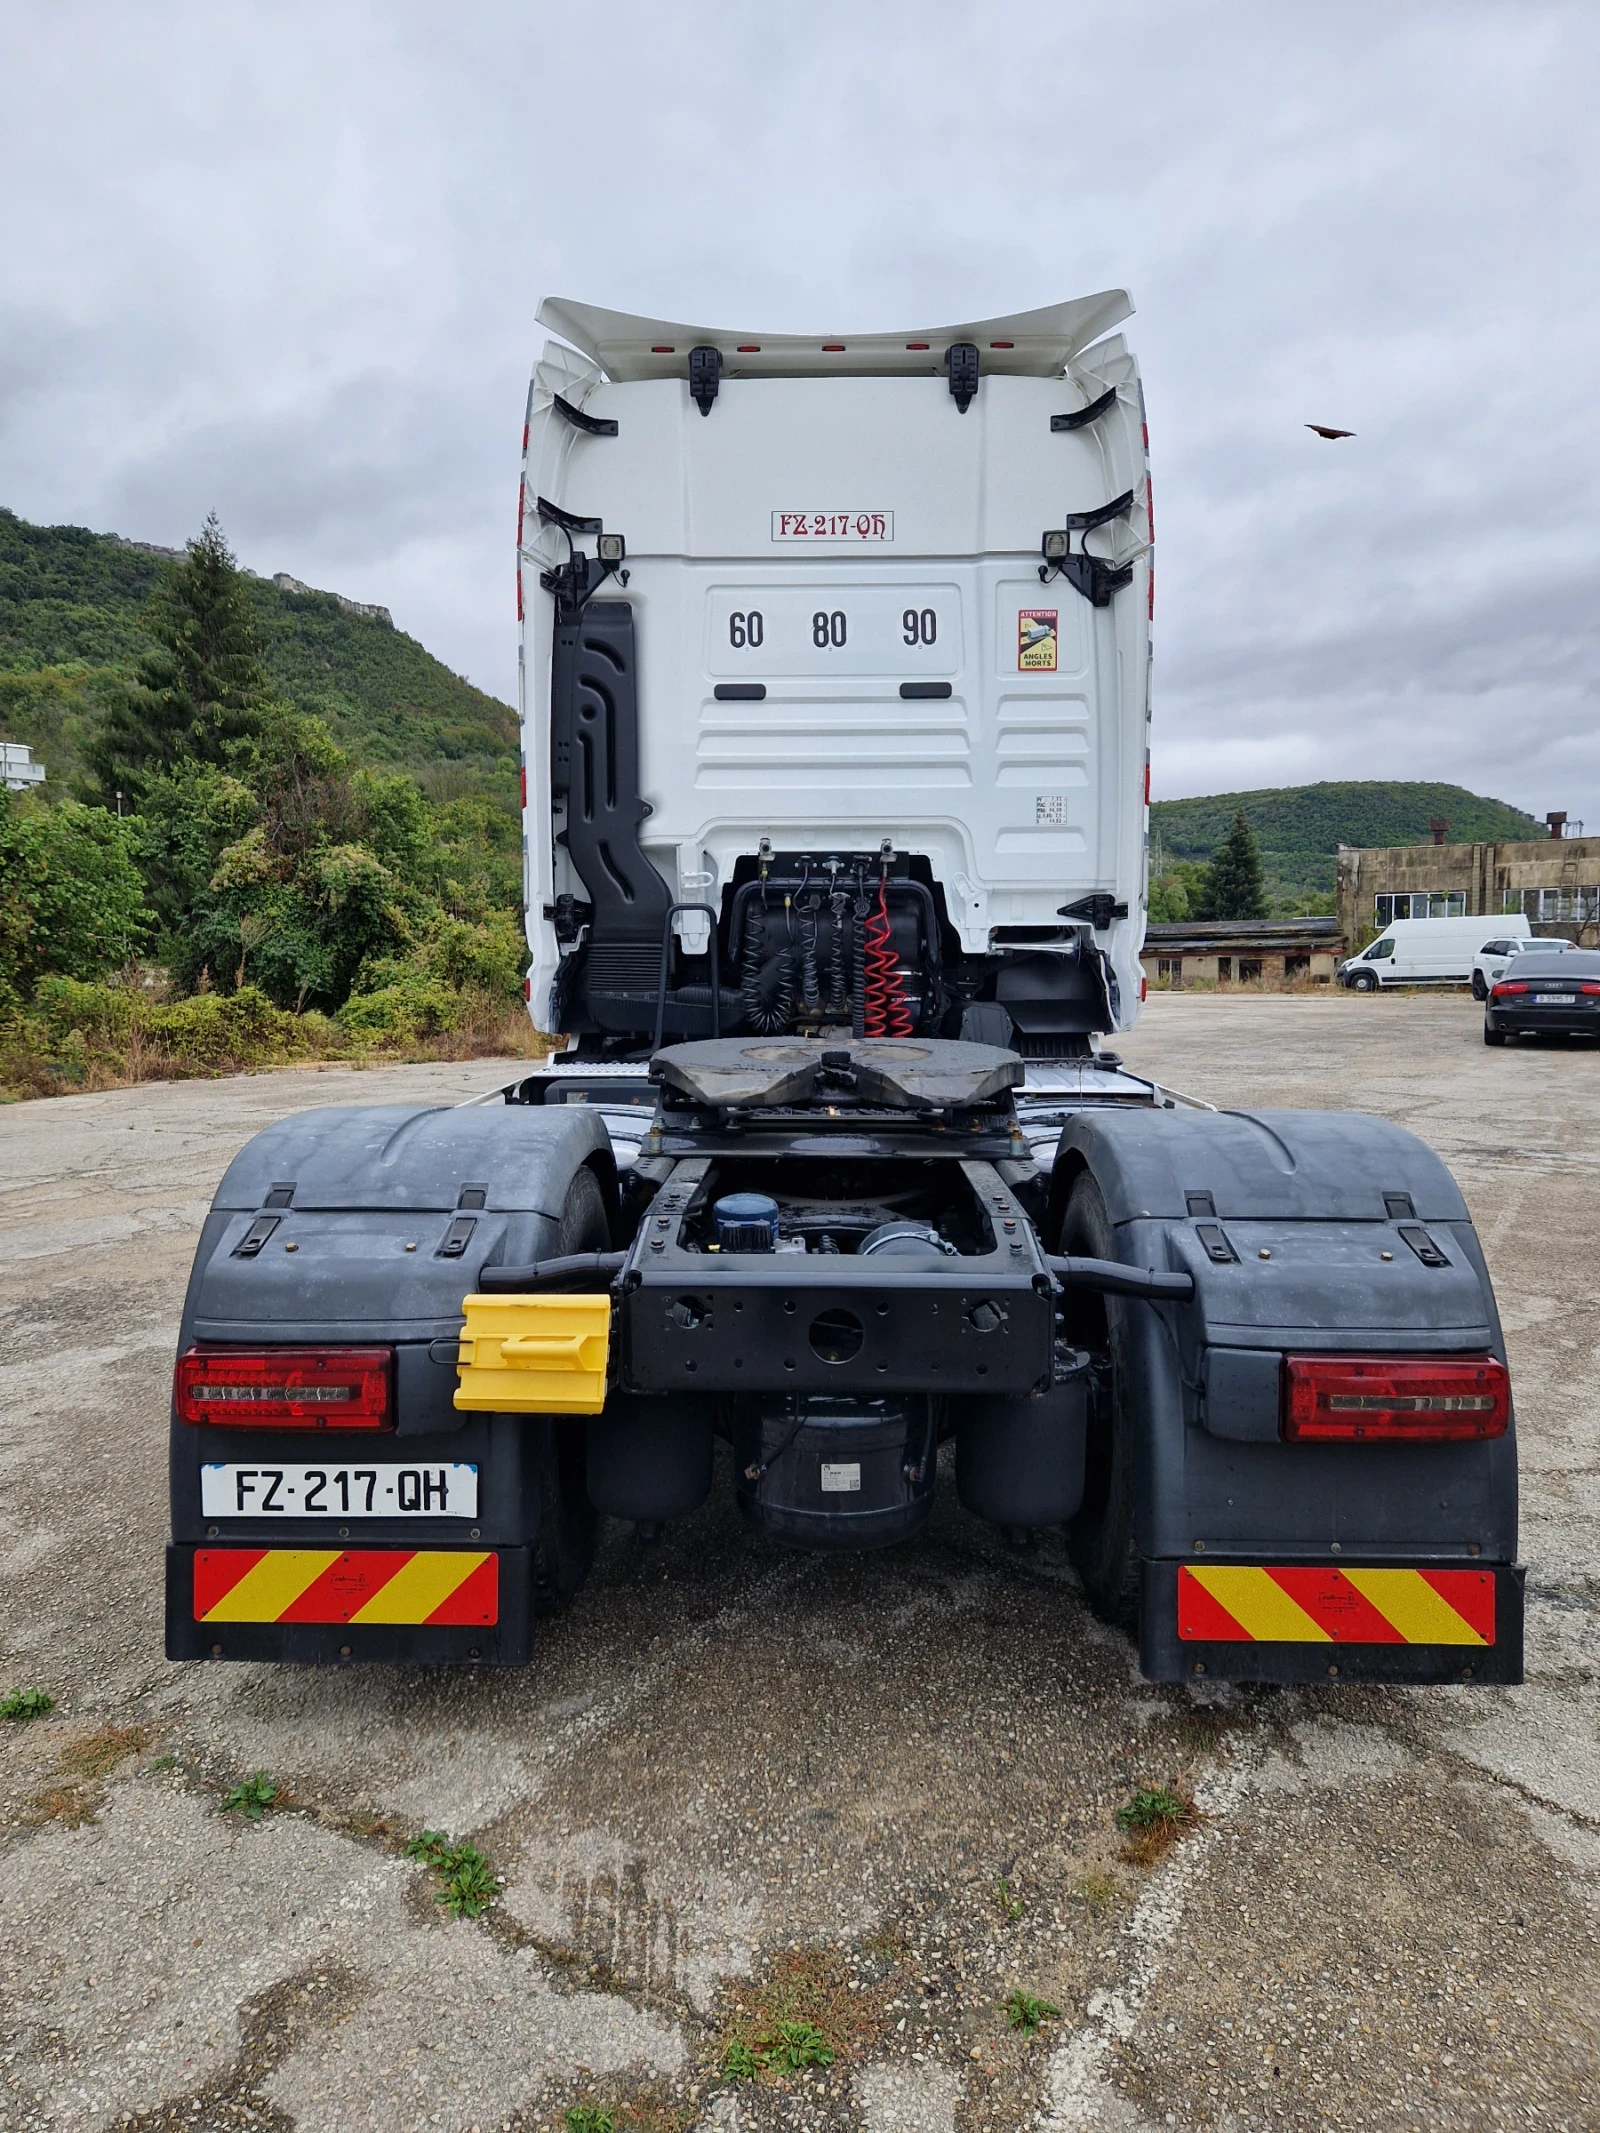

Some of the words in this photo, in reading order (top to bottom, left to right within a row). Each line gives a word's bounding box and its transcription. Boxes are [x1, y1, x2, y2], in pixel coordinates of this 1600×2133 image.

[729, 611, 764, 649] 60
[812, 610, 847, 649] 80
[902, 608, 937, 646] 90
[236, 1470, 448, 1512] FZ-217-QH
